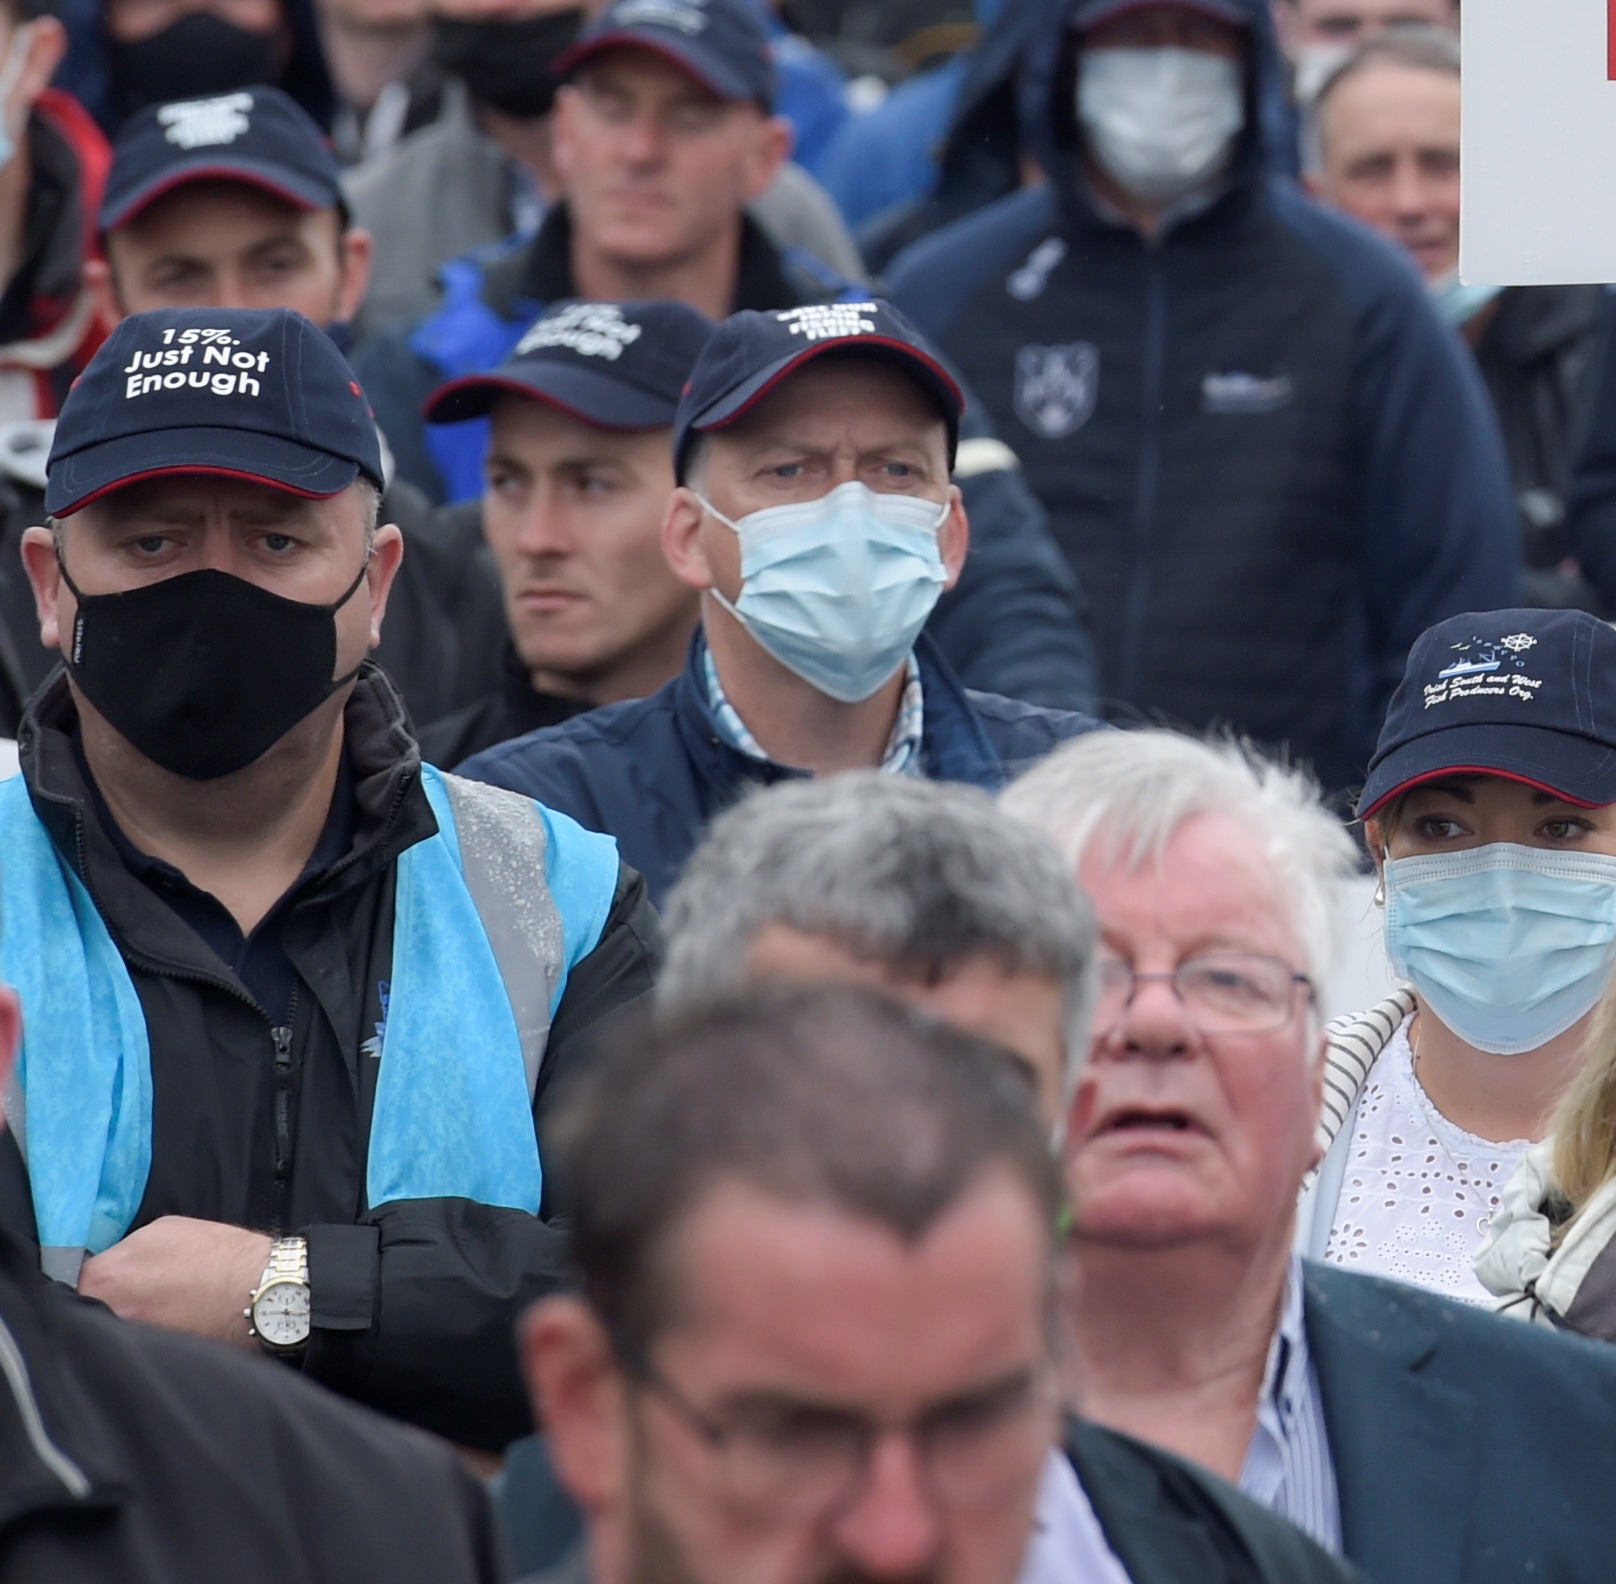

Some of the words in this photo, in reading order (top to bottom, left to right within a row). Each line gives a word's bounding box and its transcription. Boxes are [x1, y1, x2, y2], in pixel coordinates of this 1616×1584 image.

[162, 328, 241, 346] 15%.
[124, 346, 194, 373] Just
[203, 346, 270, 373] Not
[125, 372, 261, 399] Enough
[1449, 672, 1486, 688] South
[1486, 673, 1511, 684] and
[1512, 674, 1543, 688] West
[1449, 685, 1506, 701] Producers
[1508, 685, 1535, 702] Org.
